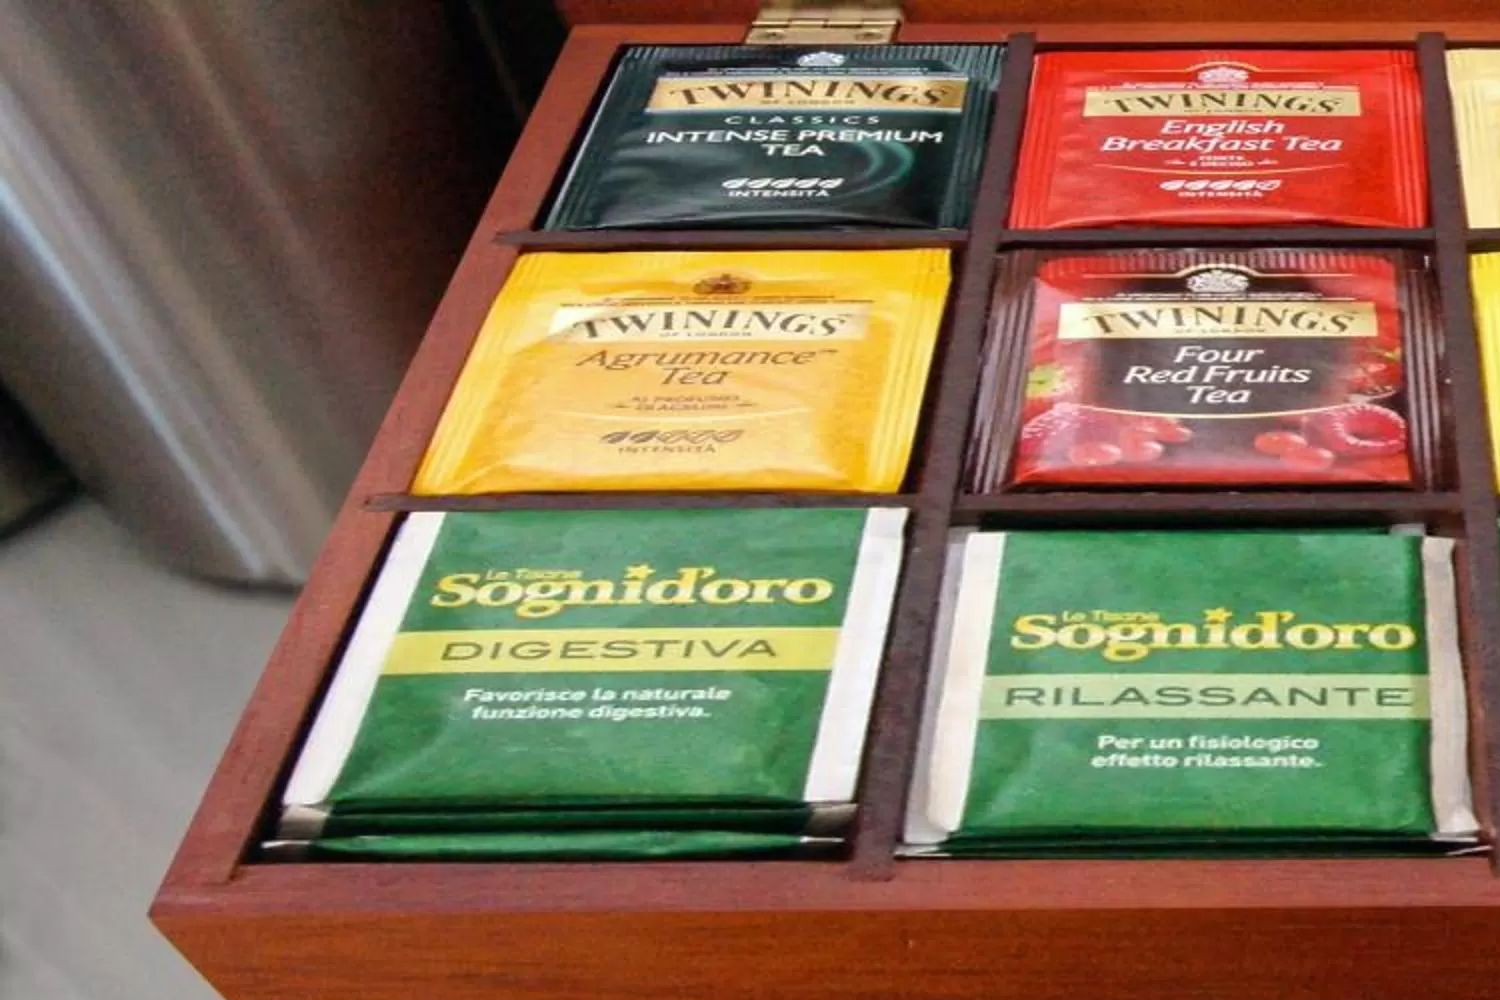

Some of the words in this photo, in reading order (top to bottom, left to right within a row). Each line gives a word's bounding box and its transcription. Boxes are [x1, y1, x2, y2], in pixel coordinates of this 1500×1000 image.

[669, 79, 950, 106] TWININGS
[1103, 91, 1345, 115] TWININGS
[724, 115, 880, 125] CLASSICS
[1161, 119, 1285, 138] English
[647, 129, 788, 143] INTENSE
[797, 129, 944, 143] PREMIUM
[1101, 135, 1273, 153] Breakfast
[1284, 135, 1344, 151] Tea
[761, 143, 825, 157] TEA
[573, 309, 852, 339] TWININGS
[1084, 306, 1358, 334] TWININGS
[1174, 345, 1264, 365] Four
[660, 368, 729, 386] Tea
[1124, 365, 1198, 385] Red
[1203, 365, 1312, 385] Fruits
[1185, 386, 1250, 404] Tea
[441, 638, 779, 662] DIGESTIVA
[463, 688, 587, 703] Favorisce
[592, 688, 618, 702] la
[622, 686, 732, 701] naturale
[1005, 686, 1415, 708] RILASSANTE
[471, 705, 583, 720] funzione
[588, 705, 711, 721] digestiva.
[1097, 735, 1145, 750] Per
[1148, 737, 1183, 750] un
[1188, 734, 1319, 754] fisiologico
[1091, 752, 1178, 768] effetto
[1184, 752, 1323, 768] rilassante.
